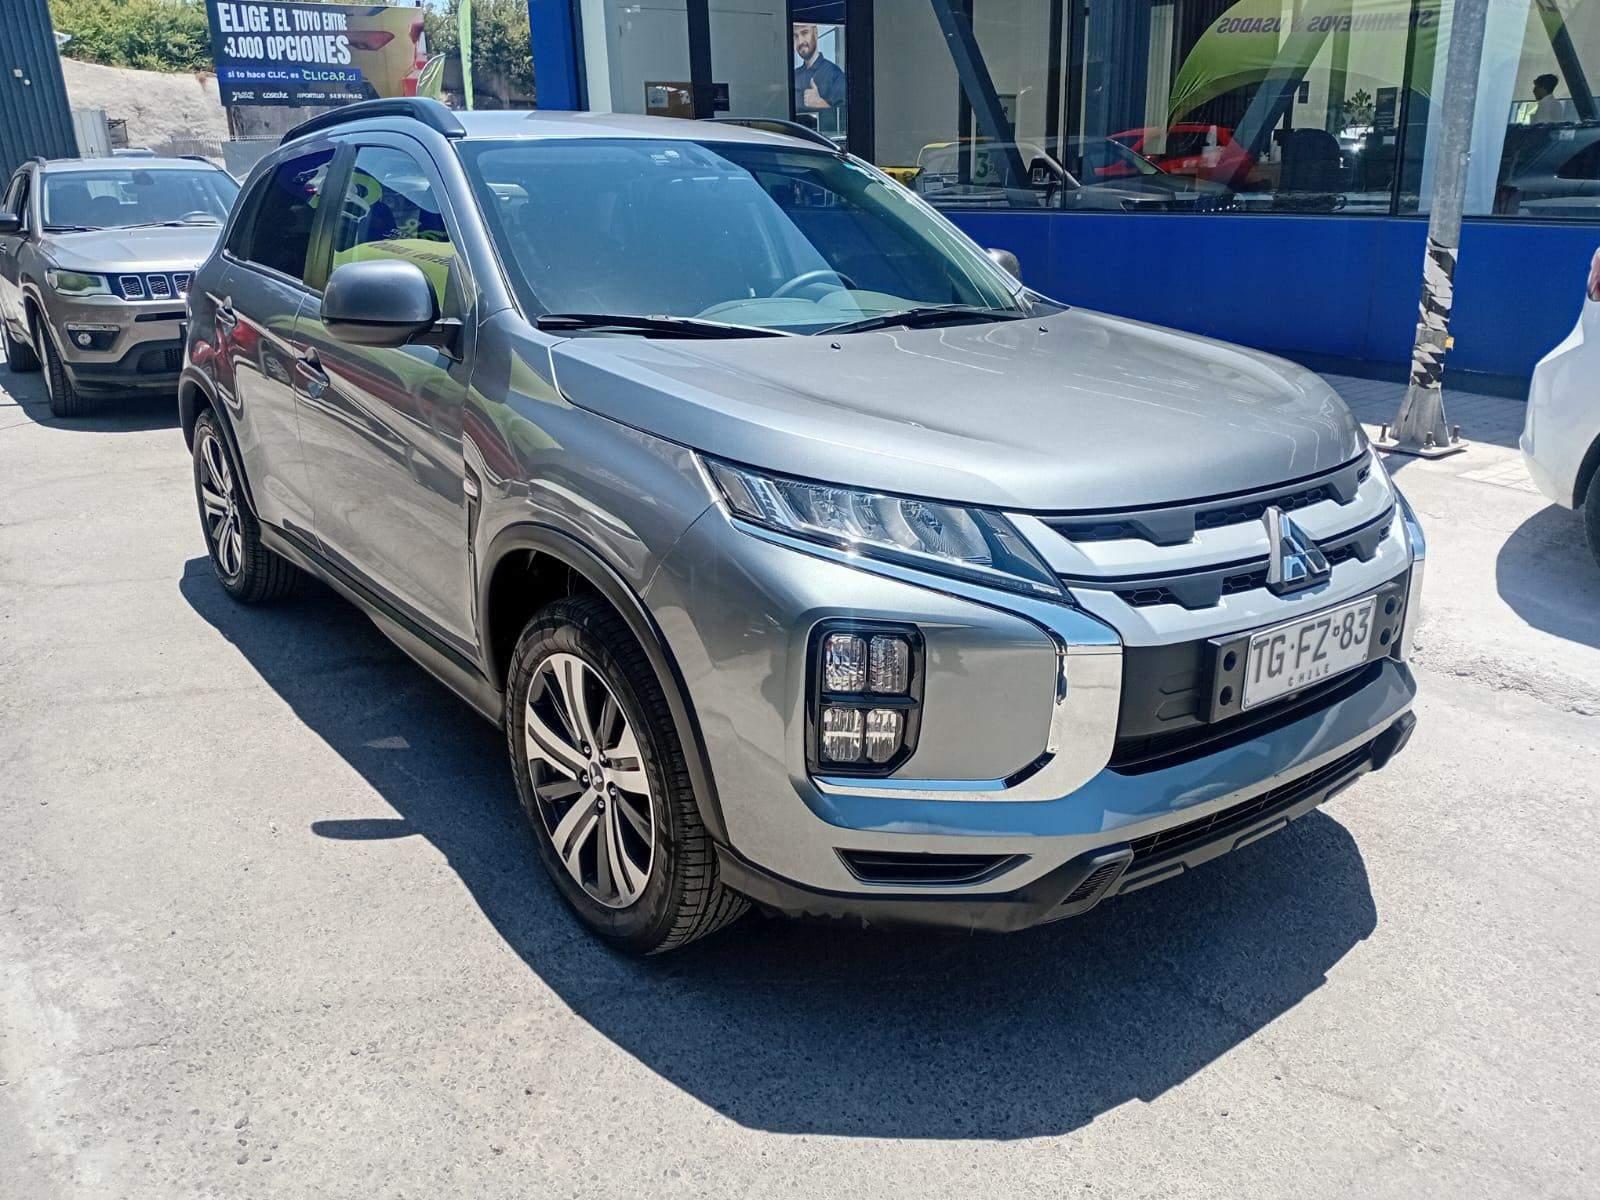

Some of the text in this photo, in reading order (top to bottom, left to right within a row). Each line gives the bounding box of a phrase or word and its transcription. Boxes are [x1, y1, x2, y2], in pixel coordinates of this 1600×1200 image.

[217, 2, 348, 32] ELIGE EL TUYO ENTRE
[223, 35, 351, 65] +3.000 OPCIONES
[227, 70, 235, 78] si
[236, 70, 245, 78] te
[246, 70, 266, 78] hace
[267, 71, 289, 80] CLIC,
[1287, 663, 1330, 687] CHILE
